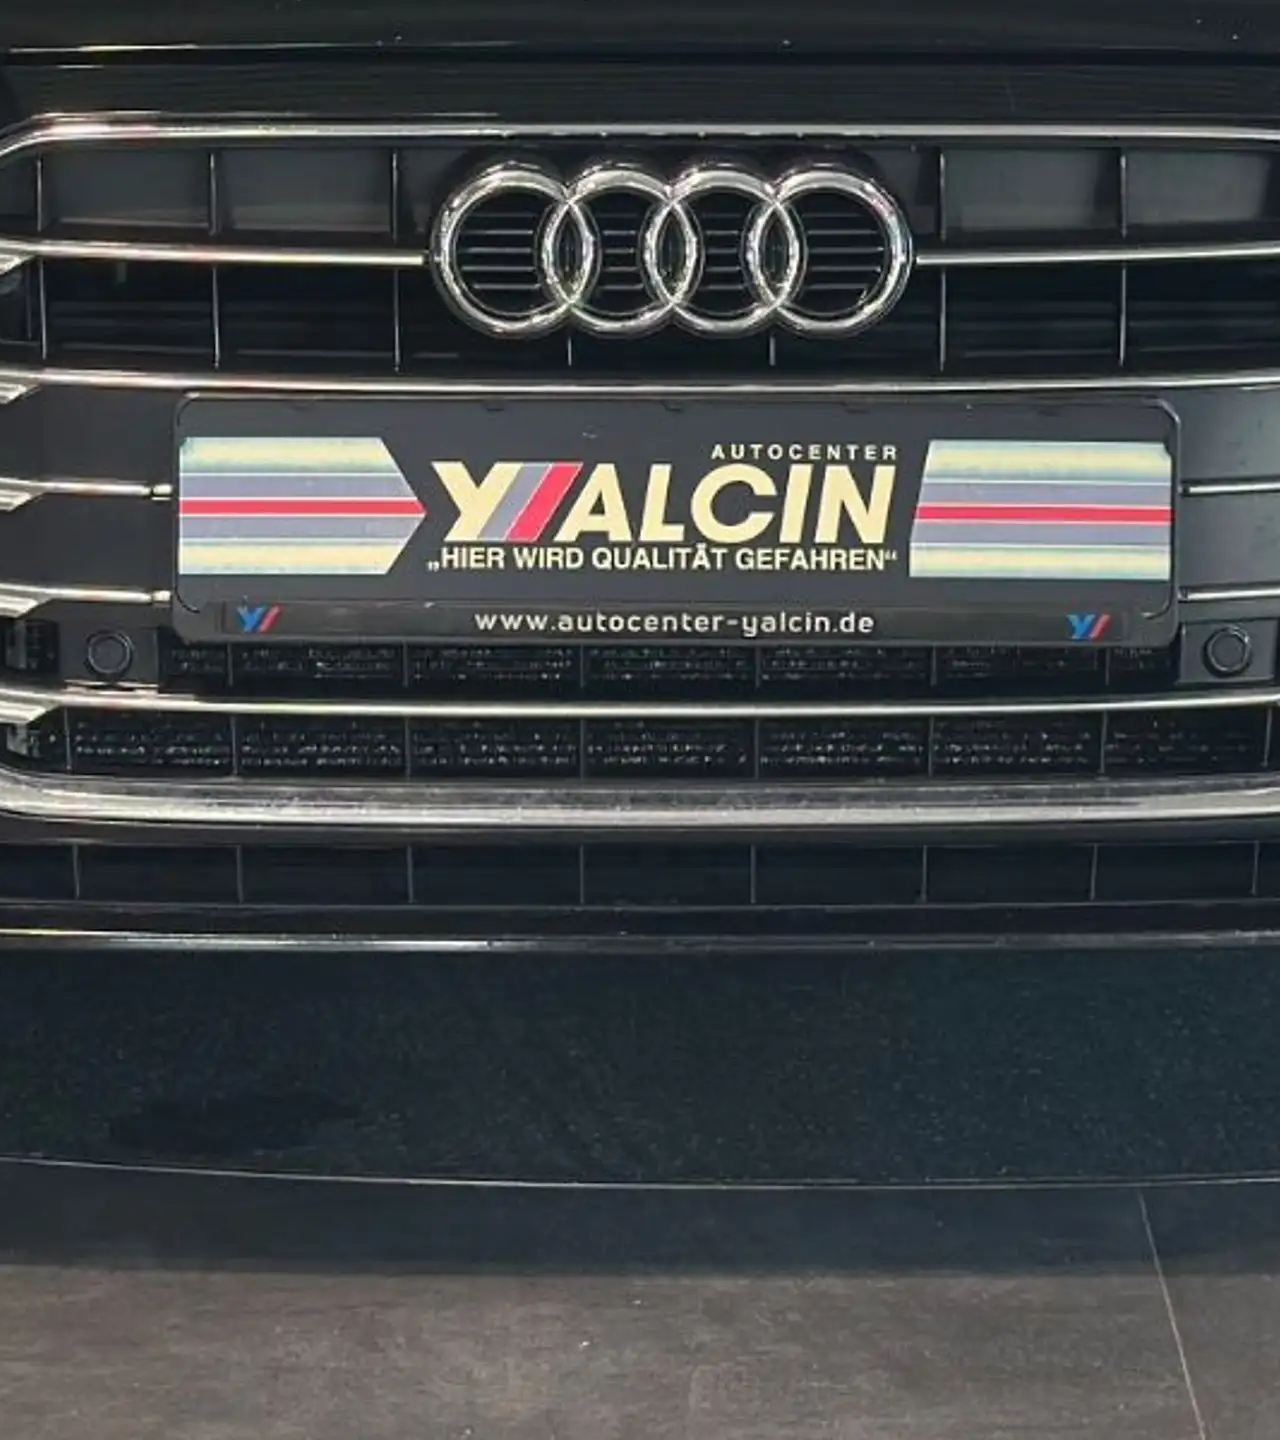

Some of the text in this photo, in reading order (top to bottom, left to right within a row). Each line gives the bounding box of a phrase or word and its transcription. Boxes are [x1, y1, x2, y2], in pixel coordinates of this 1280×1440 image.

[710, 444, 898, 461] AUTOCENTER
[511, 547, 584, 570] WIRD
[591, 543, 728, 572] QUALITÄT
[474, 610, 876, 639] www.autocenter-yalcin.de
